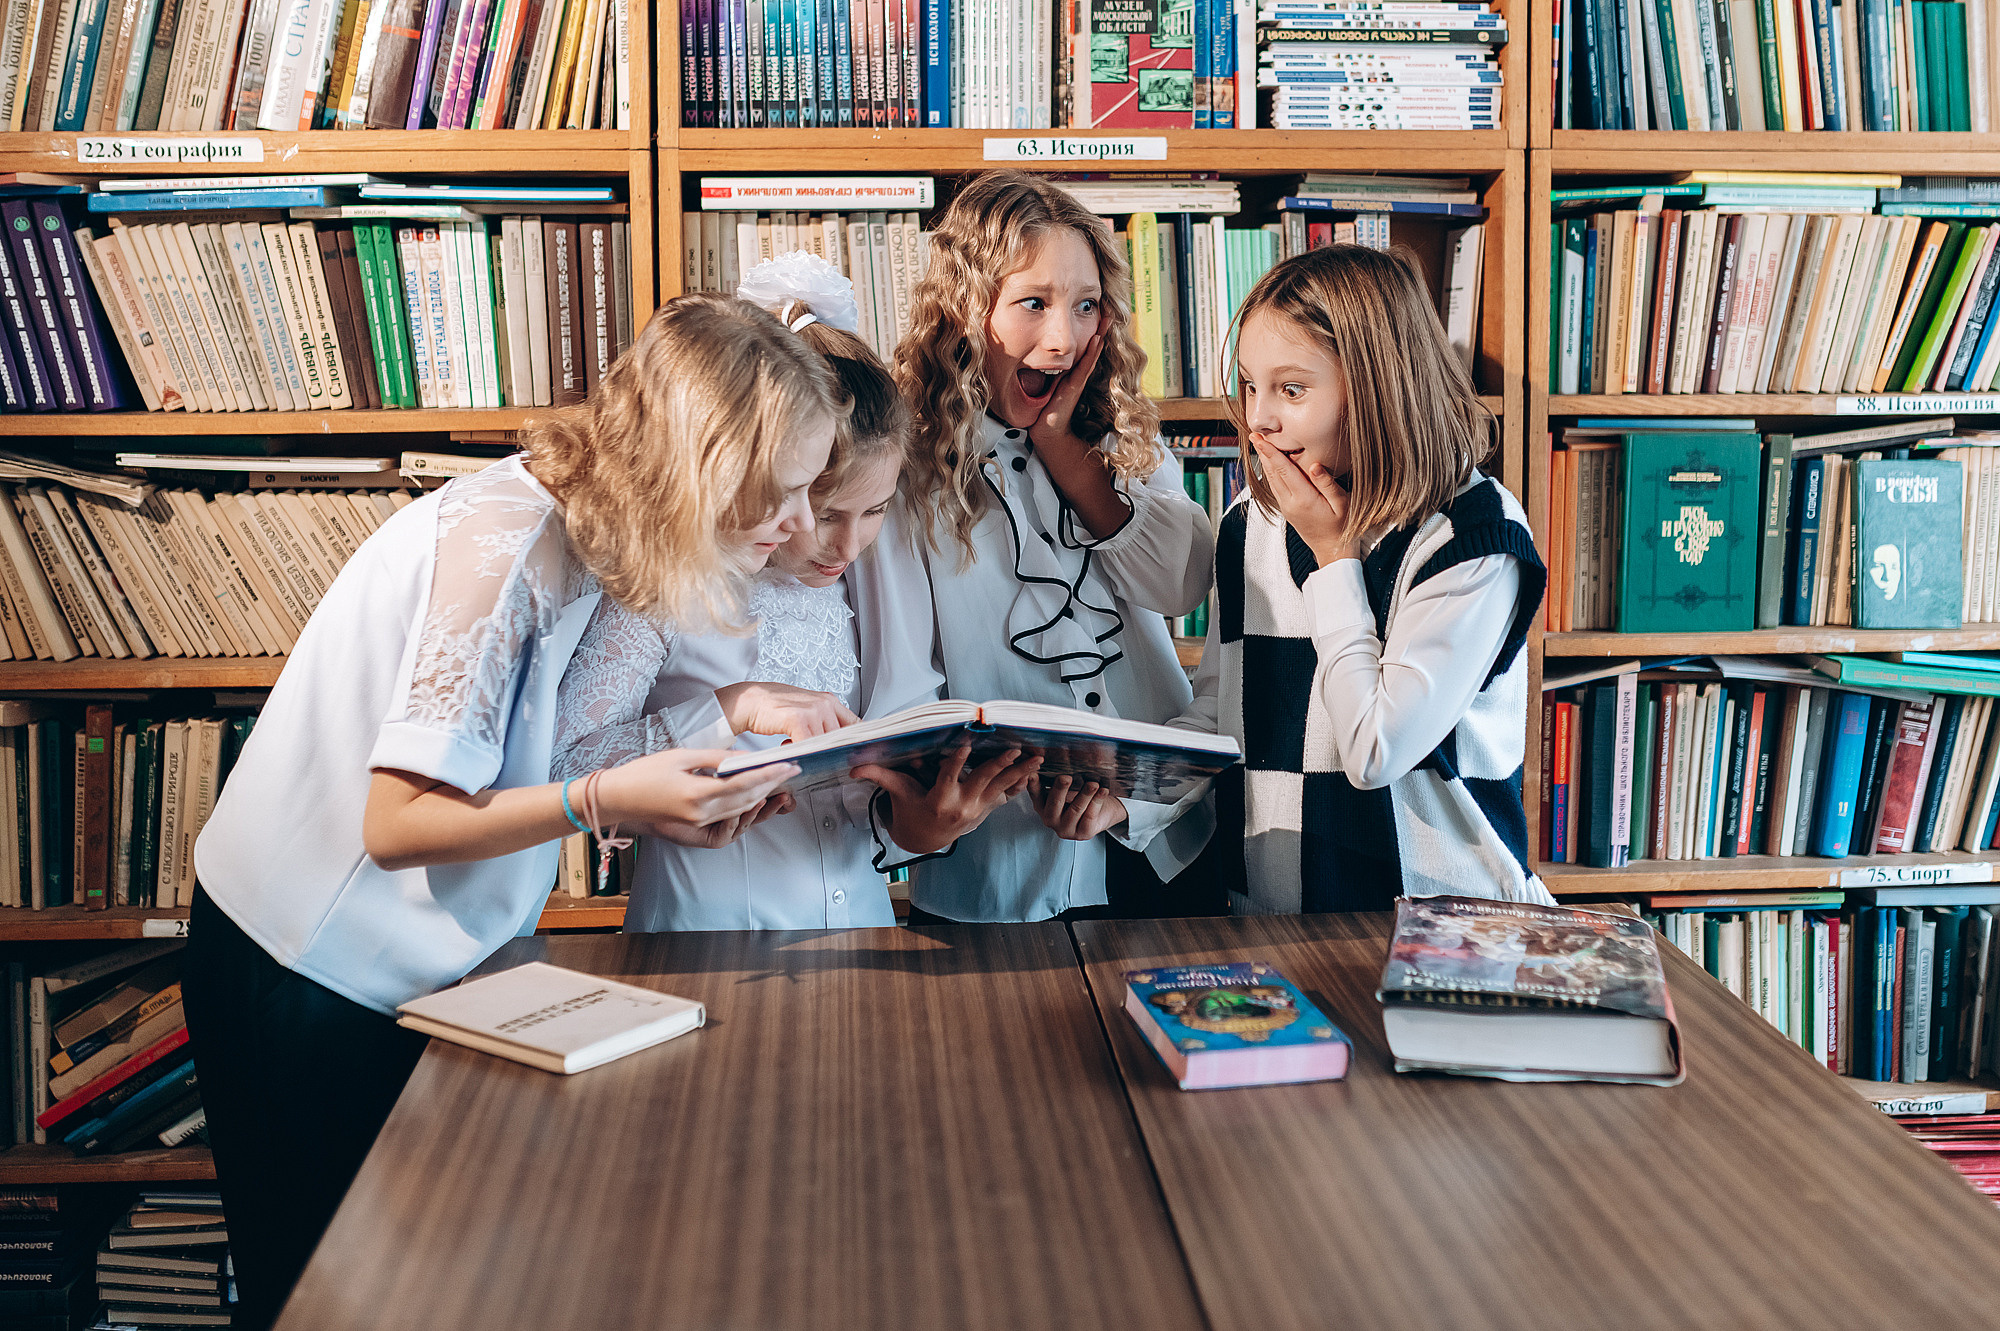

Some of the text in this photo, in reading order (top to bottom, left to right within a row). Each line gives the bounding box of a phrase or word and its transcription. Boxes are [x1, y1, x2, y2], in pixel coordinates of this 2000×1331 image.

[1093, 9, 1153, 21] МОСКОВСКОЙ
[1099, 22, 1146, 33] ОБЛАСТИ
[1266, 29, 1430, 41] НЕ СЧЕСТЬ У РОБОТА ПРОФЕССИЙ
[1, 1, 27, 121] ШКОЛА ЮННАТОВ
[248, 32, 266, 67] 1000
[434, 7, 458, 93] МИР ВЕКЕ
[620, 20, 628, 63] ОСНОВЫ
[273, 65, 292, 117] МАЛАЯ
[688, 56, 697, 101] ИСТОРИЯ
[704, 56, 714, 101] ИСТОРИЯ
[720, 56, 728, 101] ИСТОРИЯ
[738, 56, 746, 101] ИСТОРИЯ
[754, 56, 762, 101] ИСТОРИЯ
[771, 56, 780, 101] ИСТОРИЯ
[786, 56, 795, 101] ИСТОРИЯ
[804, 54, 813, 99] ИСТОРИЯ
[824, 56, 832, 101] ИСТОРИЯ
[842, 56, 850, 101] ИСТОРИЯ
[860, 54, 869, 99] ИСТОРИЯ
[875, 56, 884, 101] ИСТОРИЯ
[890, 54, 898, 99] ИСТОРИЯ
[910, 54, 919, 99] ИСТОРИЯ
[190, 94, 203, 109] 10
[622, 101, 629, 112] 9
[84, 139, 123, 159] 22.8
[1017, 138, 1135, 160] 63. История
[260, 175, 318, 186] БУКВАРЬ
[737, 187, 915, 196] НАСТОЛЬНЫЙ СПРАВОЧНИК ШКОЛЬНИКА
[358, 230, 368, 246] 2
[376, 230, 387, 246] 2
[908, 229, 920, 265] ВЕКОВ
[3, 277, 16, 297] для
[239, 262, 259, 304] СТРАНАМ
[257, 260, 276, 303] СТРАНАМ
[891, 228, 910, 320] СРЕДНИХ ВЕКОВ
[1144, 267, 1153, 313] ЭСТЕТИКА
[22, 237, 77, 404] Экологическая книга для чтения
[52, 237, 105, 404] Экологическая книга для чтения
[404, 270, 430, 379] ПОД ЛУЧАМИ ГЕЛИОСА
[428, 270, 450, 379] ПОД ЛУЧАМИ ГЕЛИОСА
[449, 281, 464, 345] ЭВОЛЮЦИЯ
[464, 280, 479, 344] ЭВОЛЮЦИЯ
[478, 280, 491, 344] ЭВОЛЮЦИЯ
[257, 317, 281, 374] МАТЕРИКАМ
[273, 317, 296, 372] МАТЕРИКАМ
[559, 308, 574, 388] НА СУШЕ И НА
[595, 308, 608, 371] СУШЕ И НА
[299, 332, 323, 398] Словарь
[318, 332, 343, 398] Словарь
[1857, 396, 1994, 412] 88. Психология
[300, 474, 340, 483] БИОЛОГИЯ
[1875, 476, 1885, 493] В
[1887, 484, 1938, 504] СЕБЯ
[1662, 520, 1672, 537] И
[1688, 537, 1710, 552] 1812
[253, 509, 314, 600] ОБЩЕЙ БИОЛОГИИ
[147, 605, 166, 635] КНИГА
[1617, 691, 1631, 838] СПРАВОЧНИК ШКОЛЬНОГО БИБЛИОТЕКАРЯ
[1760, 753, 1769, 776] СЕБЯ
[162, 752, 178, 884] С ЛЮБОВЬЮ К ПРИРОДЕ
[1556, 807, 1564, 852] ИСКУССТВО
[1867, 866, 1952, 884] 75. Спорт
[1453, 903, 1473, 916] Art
[1475, 904, 1526, 919] Russian
[1526, 911, 1541, 921] of
[1917, 1019, 1926, 1050] ОХРАНА
